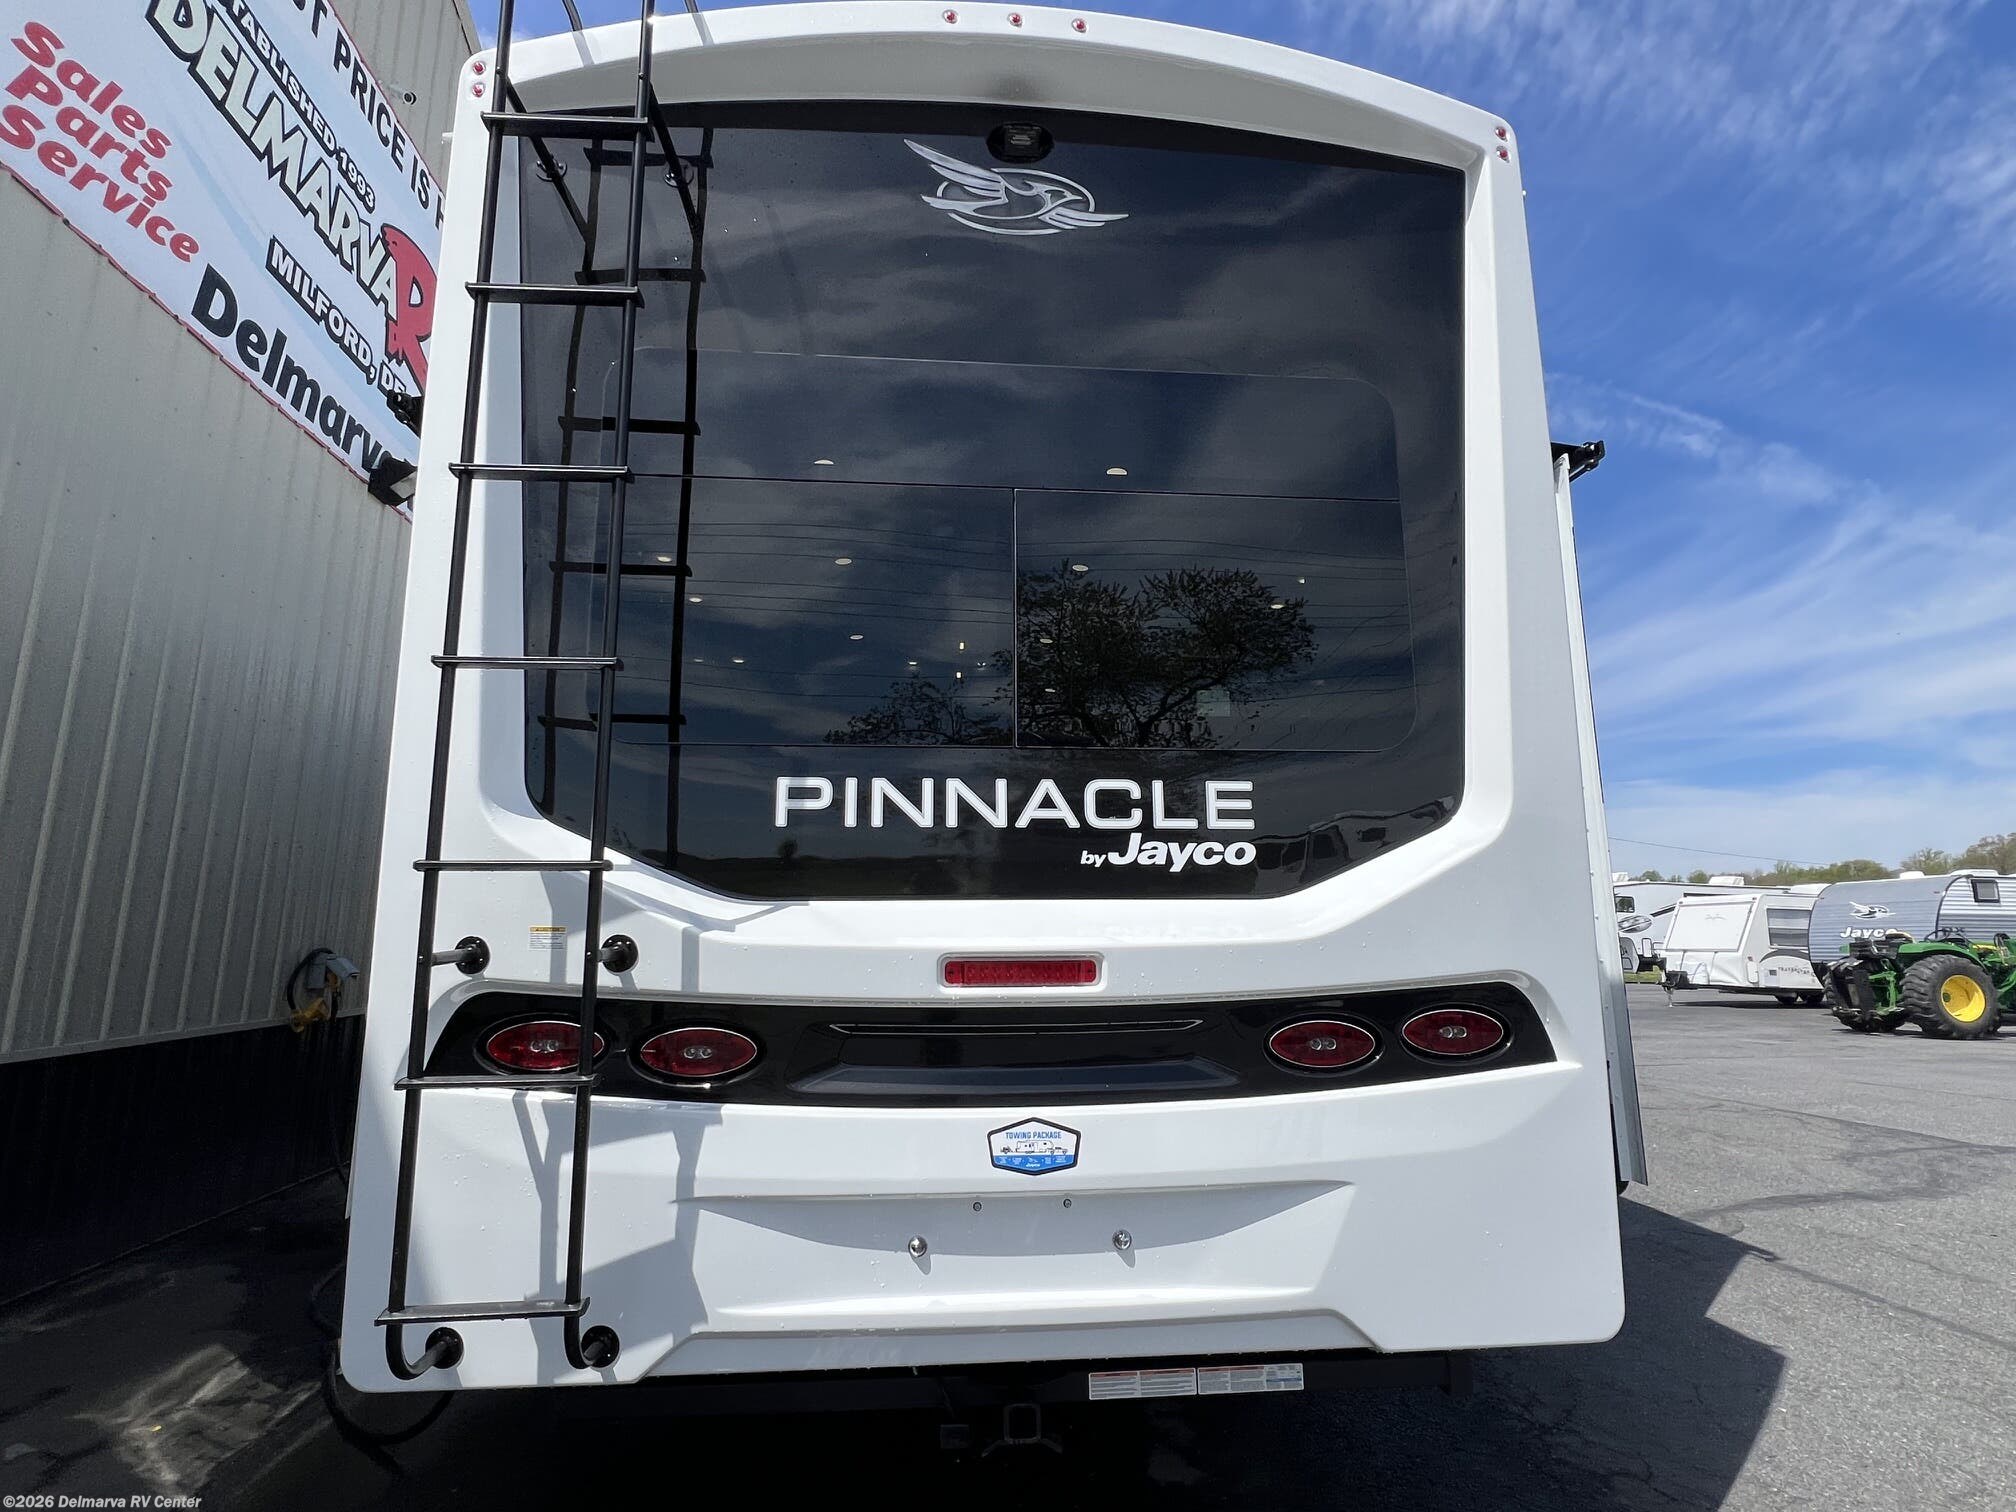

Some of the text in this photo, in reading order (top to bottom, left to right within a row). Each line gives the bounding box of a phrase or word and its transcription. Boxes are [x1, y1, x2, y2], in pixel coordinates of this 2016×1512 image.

[5, 64, 173, 201] Parts
[11, 21, 172, 159] Sales
[333, 28, 406, 173] PRICE
[410, 154, 431, 210] IS
[0, 104, 199, 263] Service
[145, 0, 399, 322] DELMARVA
[338, 151, 375, 211] 1993
[191, 263, 394, 473] Delmarv
[270, 240, 376, 382] MILFORD,
[775, 776, 1256, 830] PINNACLE
[1080, 832, 1257, 872] by Jayco
[1005, 1131, 1062, 1139] TOWING PACKAGE
